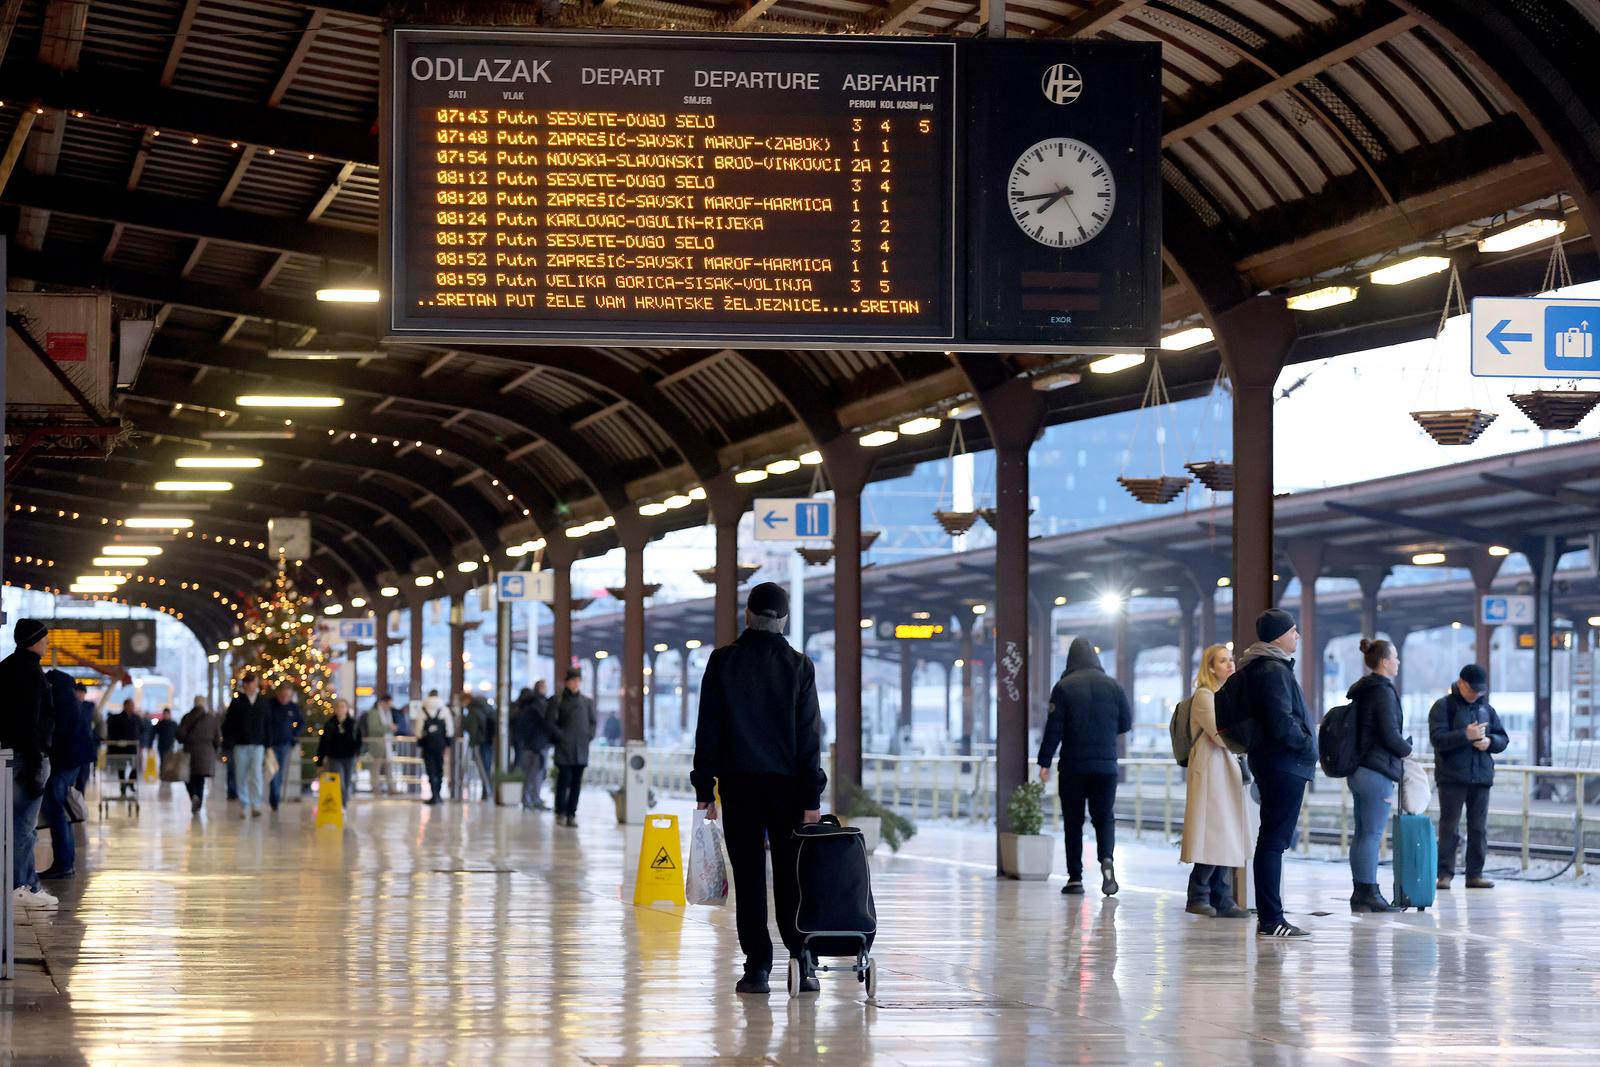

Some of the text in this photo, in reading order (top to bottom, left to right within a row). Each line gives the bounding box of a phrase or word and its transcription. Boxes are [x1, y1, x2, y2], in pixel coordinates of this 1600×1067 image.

[411, 56, 940, 93] ODLAZAK DEPART DEPARTURE ABFAHRT
[448, 90, 467, 99] SATI
[502, 91, 525, 100] VLAK
[683, 95, 713, 105] SMJER
[848, 99, 877, 109] PERON
[879, 100, 896, 109] KOL
[896, 101, 919, 110] KASNI
[436, 108, 930, 133] 07:43 Putn SESVETE-DUGO SELO 3 4 5
[436, 129, 889, 152] 07:48 Putn ZAPREŠIĆ-SAVSKI MAROF-(ZABOK) 1 1
[436, 149, 890, 172] 07:54 Putn NOVSKA-SLAVONSKI BROD-VINKOVCI 2A 2
[436, 169, 890, 192] 08:12 Putn SESVETE-DUGO SELO 3 4
[435, 190, 888, 212] 08:20 Putn ZAPREŠIĆ-SAVSKI MAROF-HARMICA 1 1
[436, 210, 890, 232] 08:24 Putn KARLOVAC-OGULIN-RIJEKA 2 2
[435, 231, 890, 252] 08:37 Putn SESVETE-DUGO SELO 3 4
[435, 251, 888, 272] 08:52 Putn ZAPREŠIĆ-SAVSKI MAROF-HARMICA 1 1
[435, 272, 890, 293] 08:59 Putn VELIKA GORICA-SISAK-VOLINJA 3 5
[506, 294, 535, 307] PUT
[546, 293, 586, 308] ŽELE
[595, 296, 625, 308] VAM
[635, 296, 714, 310] HRVATSKE
[1050, 316, 1072, 324] EXOR
